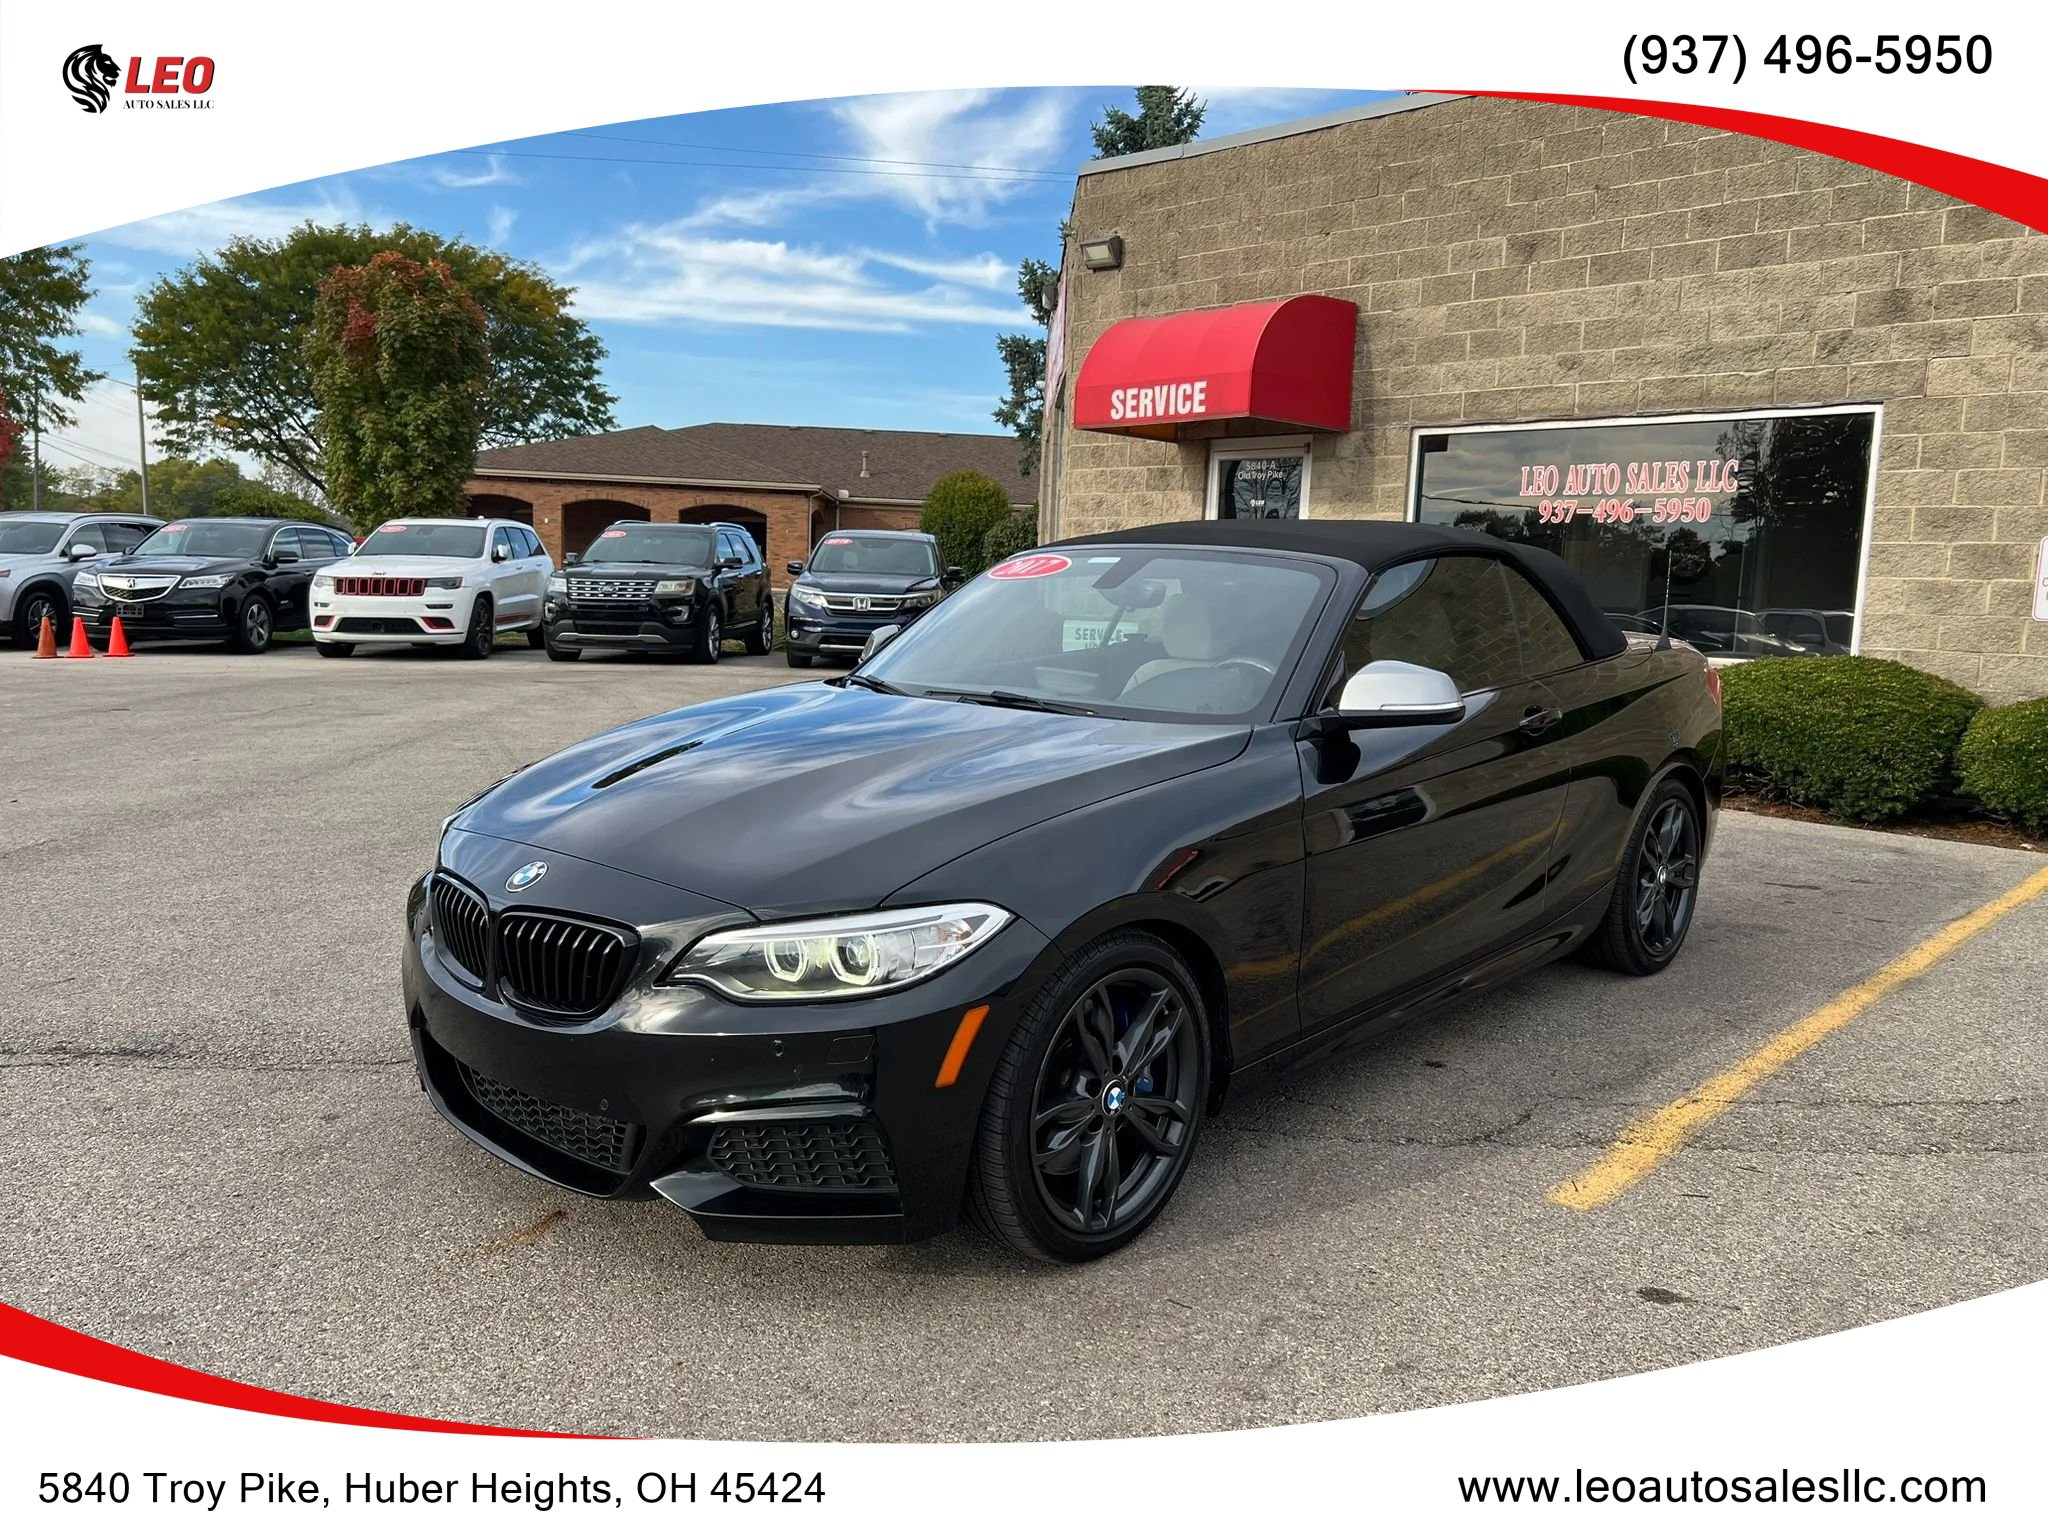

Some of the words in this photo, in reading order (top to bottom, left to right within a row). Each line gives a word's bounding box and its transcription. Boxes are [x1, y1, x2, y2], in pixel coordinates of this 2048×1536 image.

[1110, 380, 1207, 421] SERVICE
[1237, 471, 1251, 480] Old
[1267, 470, 1284, 479] Pike
[1245, 460, 1276, 471] 5840-A
[1519, 465, 1559, 496] LEO
[1563, 463, 1621, 496] AUTO
[1625, 460, 1690, 494] SALES
[1695, 459, 1739, 494] LLC
[1539, 497, 1712, 524] 937-496-5950
[1074, 627, 1122, 642] SERVE
